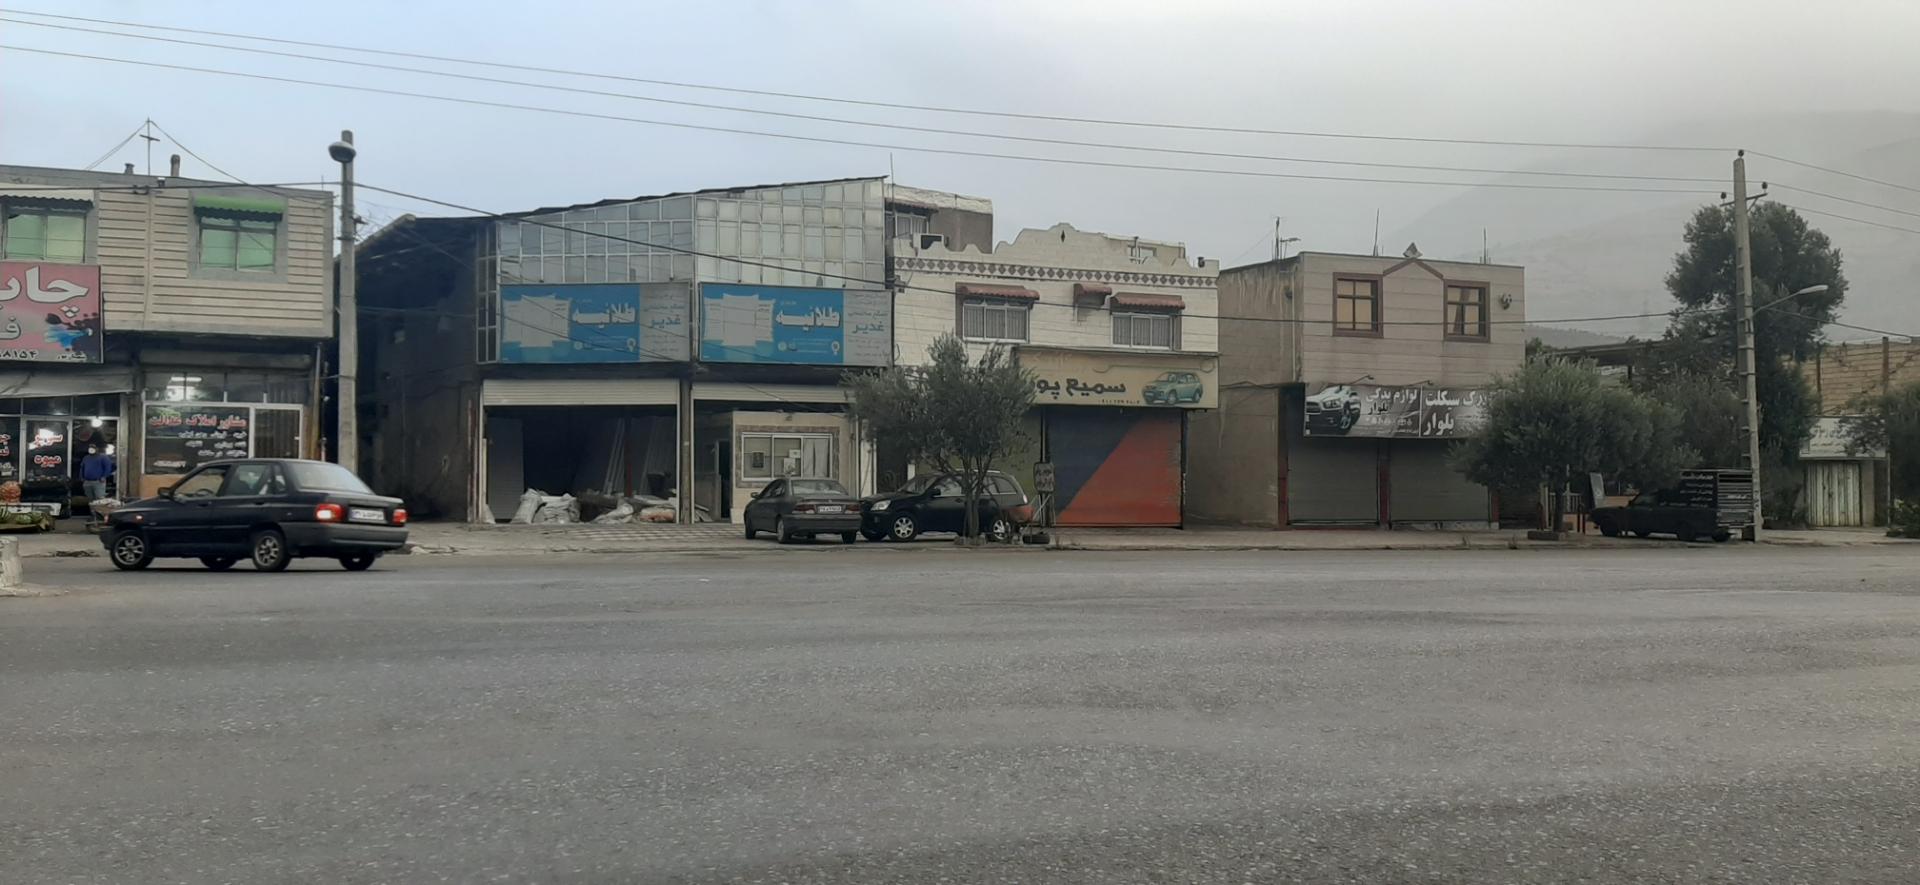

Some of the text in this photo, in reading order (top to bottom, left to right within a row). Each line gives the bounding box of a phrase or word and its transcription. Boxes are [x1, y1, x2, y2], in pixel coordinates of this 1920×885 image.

[1036, 378, 1126, 400] سمیع پو
[1366, 387, 1418, 404] لوازم یدکی
[1423, 412, 1455, 436] بلوار
